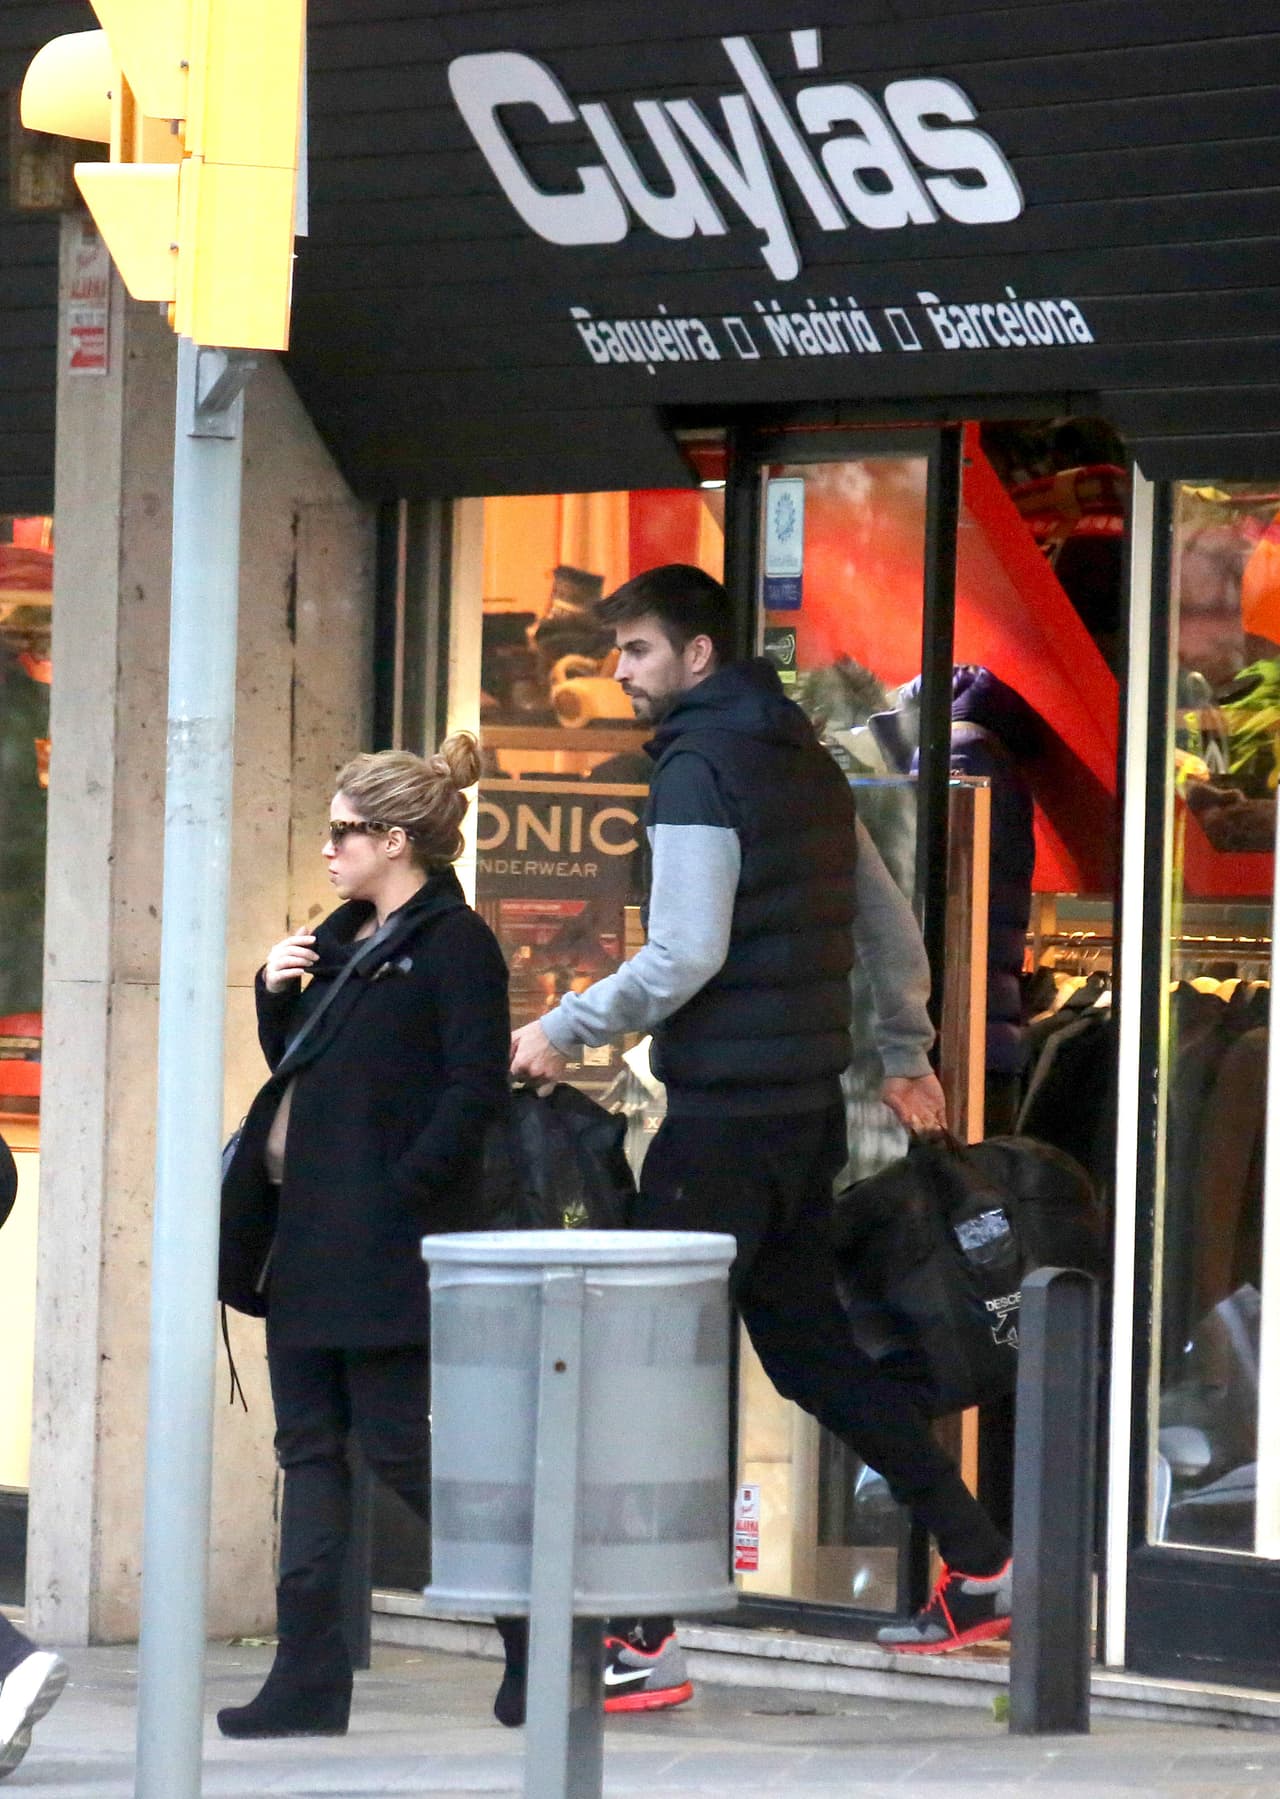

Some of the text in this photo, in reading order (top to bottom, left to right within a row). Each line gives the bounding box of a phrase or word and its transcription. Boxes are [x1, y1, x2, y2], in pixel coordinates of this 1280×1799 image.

[569, 286, 1095, 375] Baqueira Madrid Barcelona
[477, 802, 640, 856] ONIC
